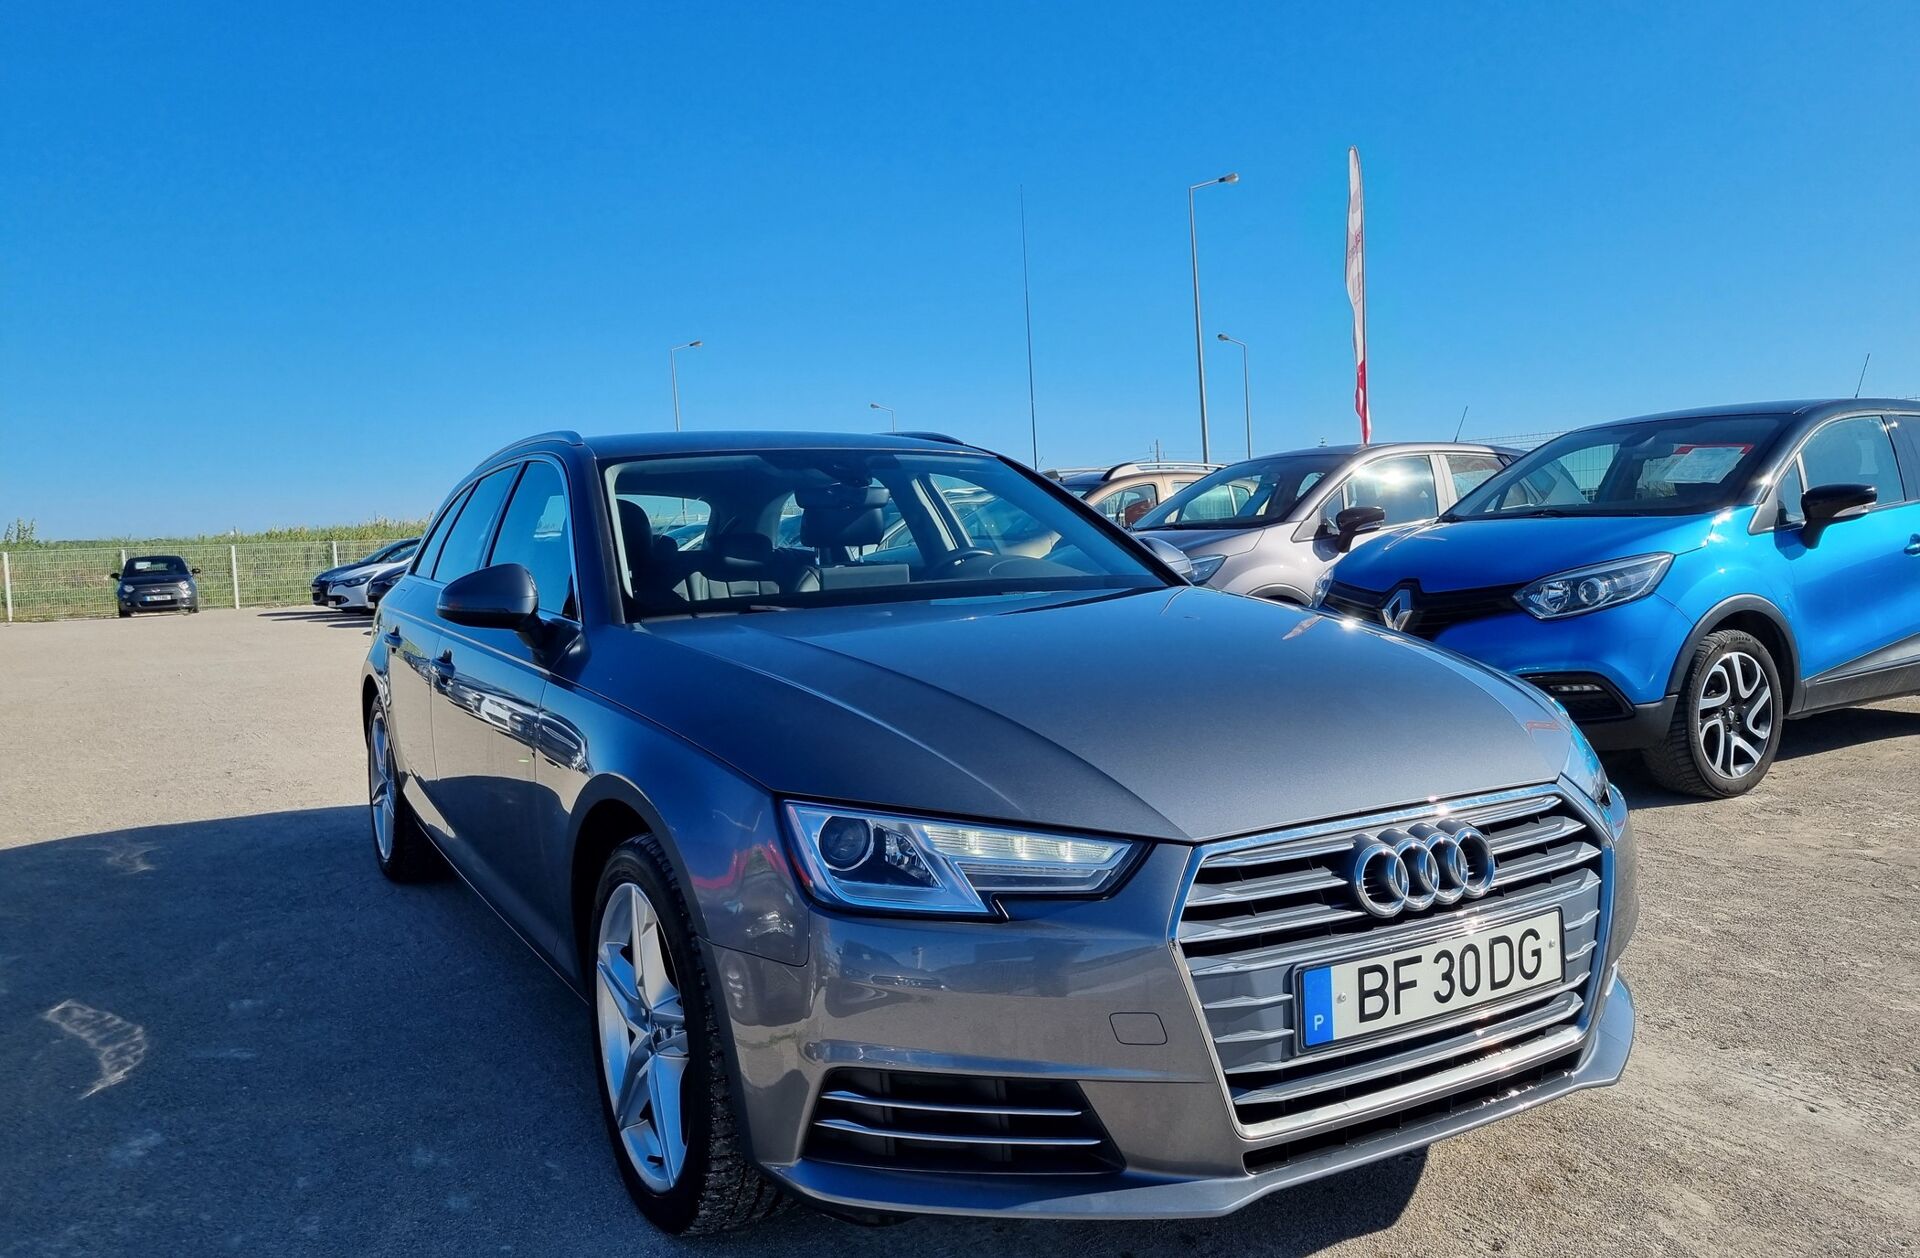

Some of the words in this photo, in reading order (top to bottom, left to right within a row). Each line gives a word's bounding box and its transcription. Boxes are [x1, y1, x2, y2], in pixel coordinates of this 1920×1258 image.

[1358, 955, 1422, 1023] BF
[1433, 943, 1480, 1003] 30
[1489, 928, 1542, 991] DG
[1314, 1014, 1324, 1031] P
